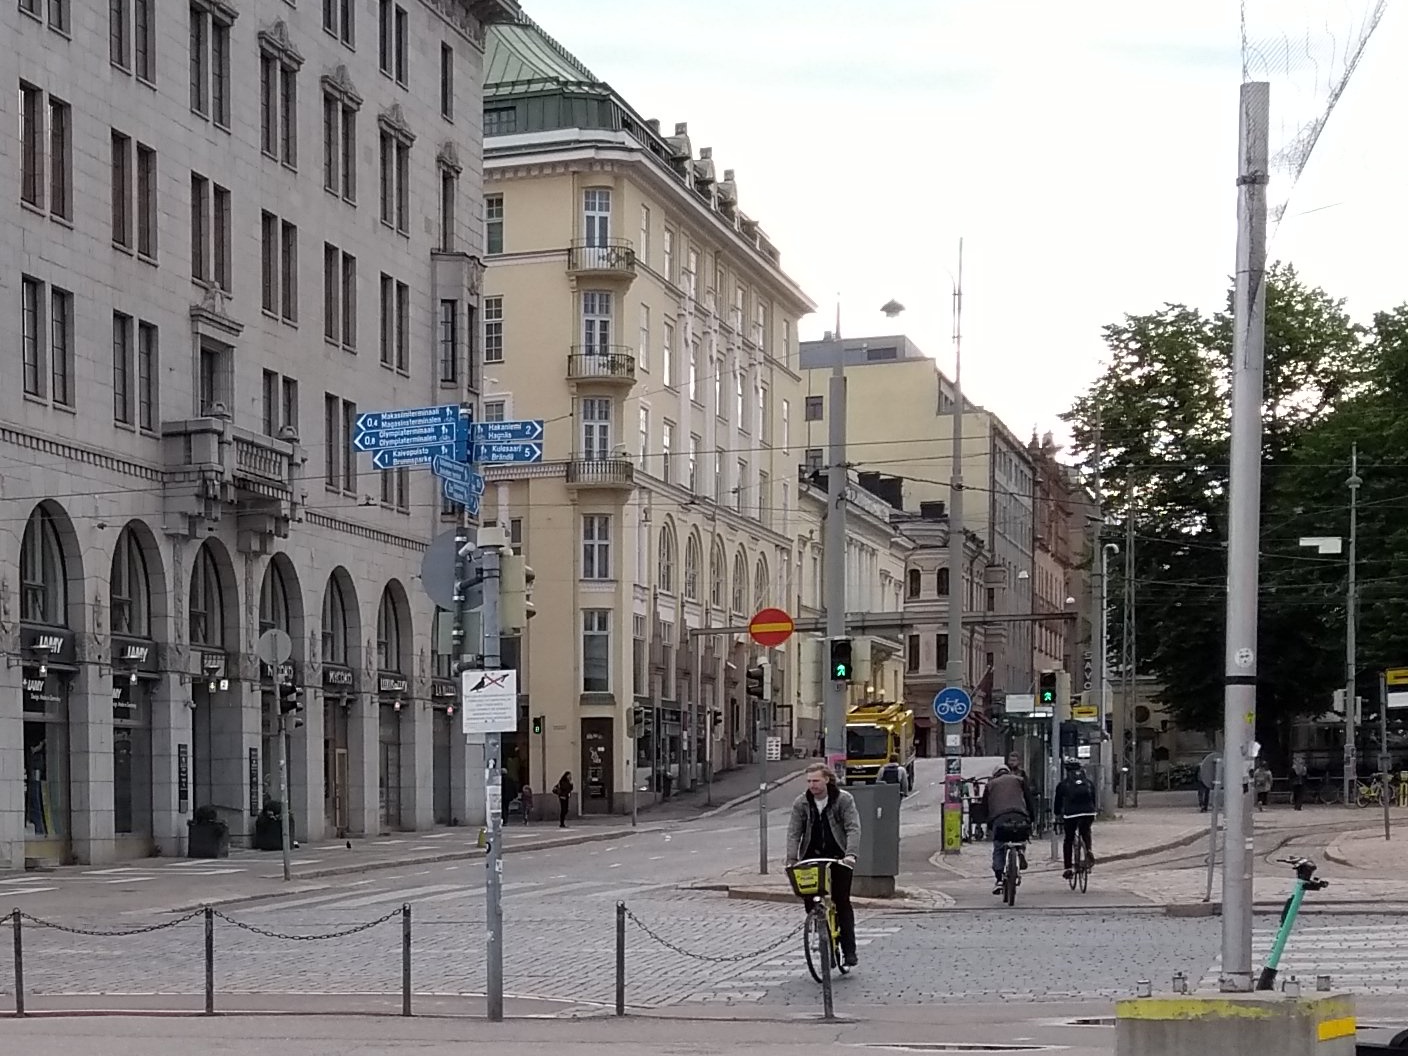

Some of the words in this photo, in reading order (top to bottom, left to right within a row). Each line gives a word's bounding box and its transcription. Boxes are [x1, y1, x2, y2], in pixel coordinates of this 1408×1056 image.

[525, 425, 531, 435] 2
[524, 448, 530, 457] 5
[385, 454, 389, 463] 1
